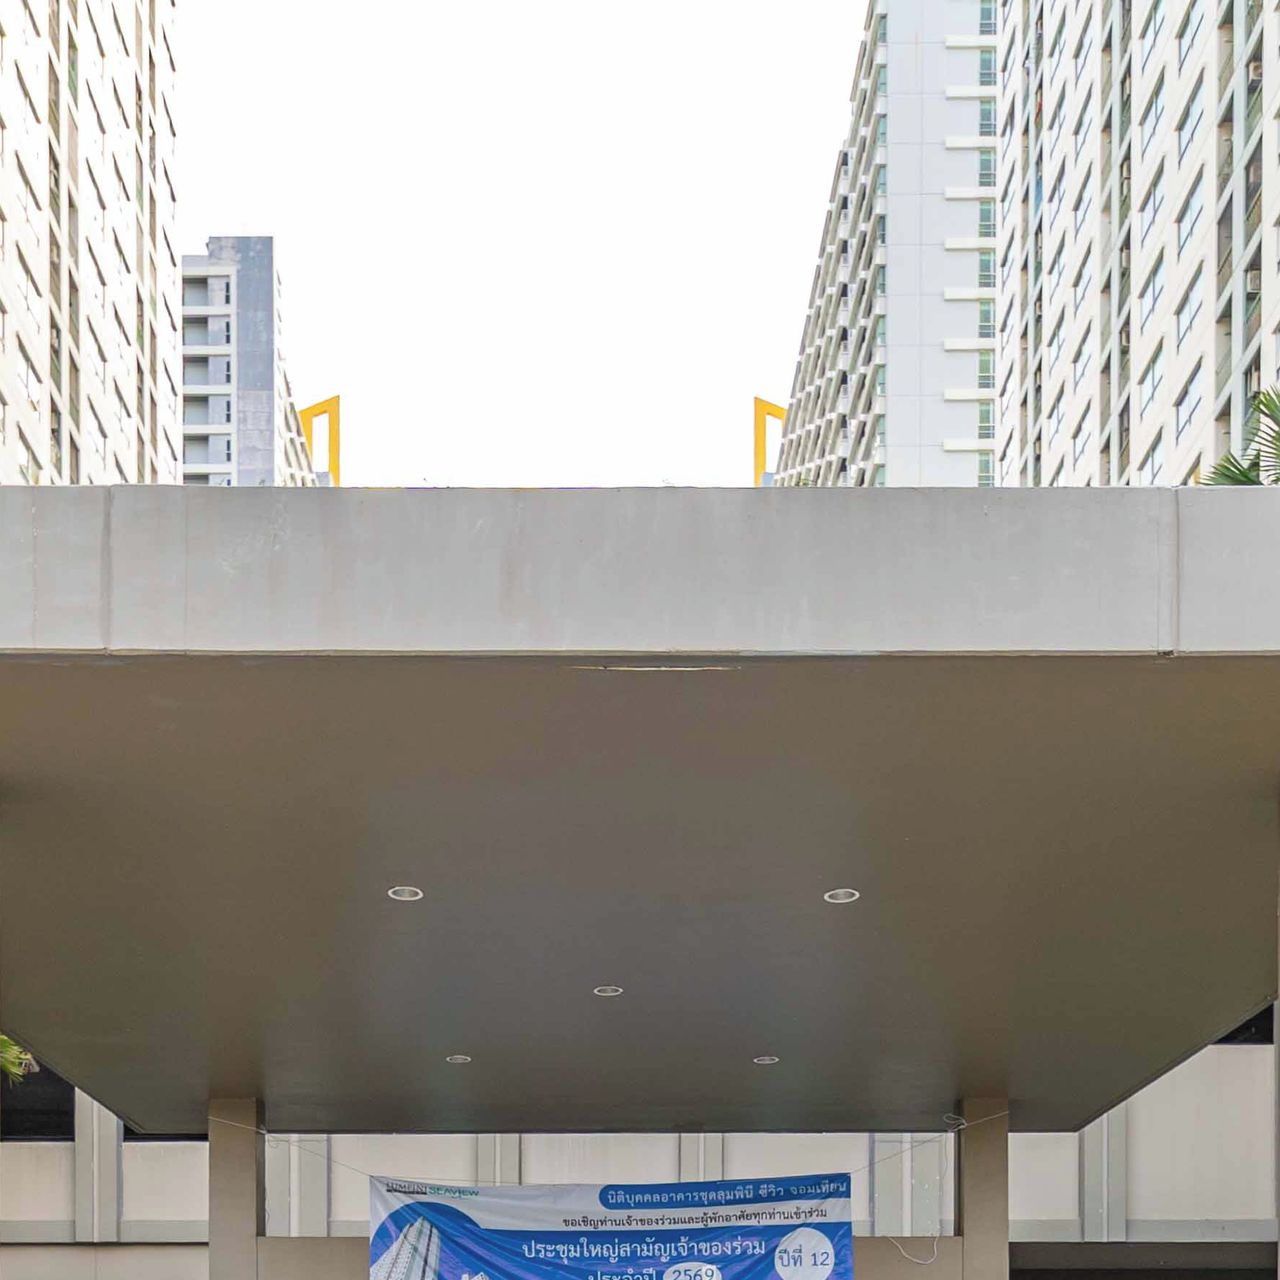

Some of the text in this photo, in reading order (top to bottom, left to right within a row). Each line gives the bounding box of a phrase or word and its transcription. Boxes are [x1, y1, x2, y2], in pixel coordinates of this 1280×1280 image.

[428, 1186, 480, 1197] SEAVIEW
[790, 1179, 847, 1196] จอมเทียน
[522, 1236, 766, 1264] ประชุมใหญ่สามัญเจ้าของร่วม
[778, 1245, 830, 1267] ปีที่ 12
